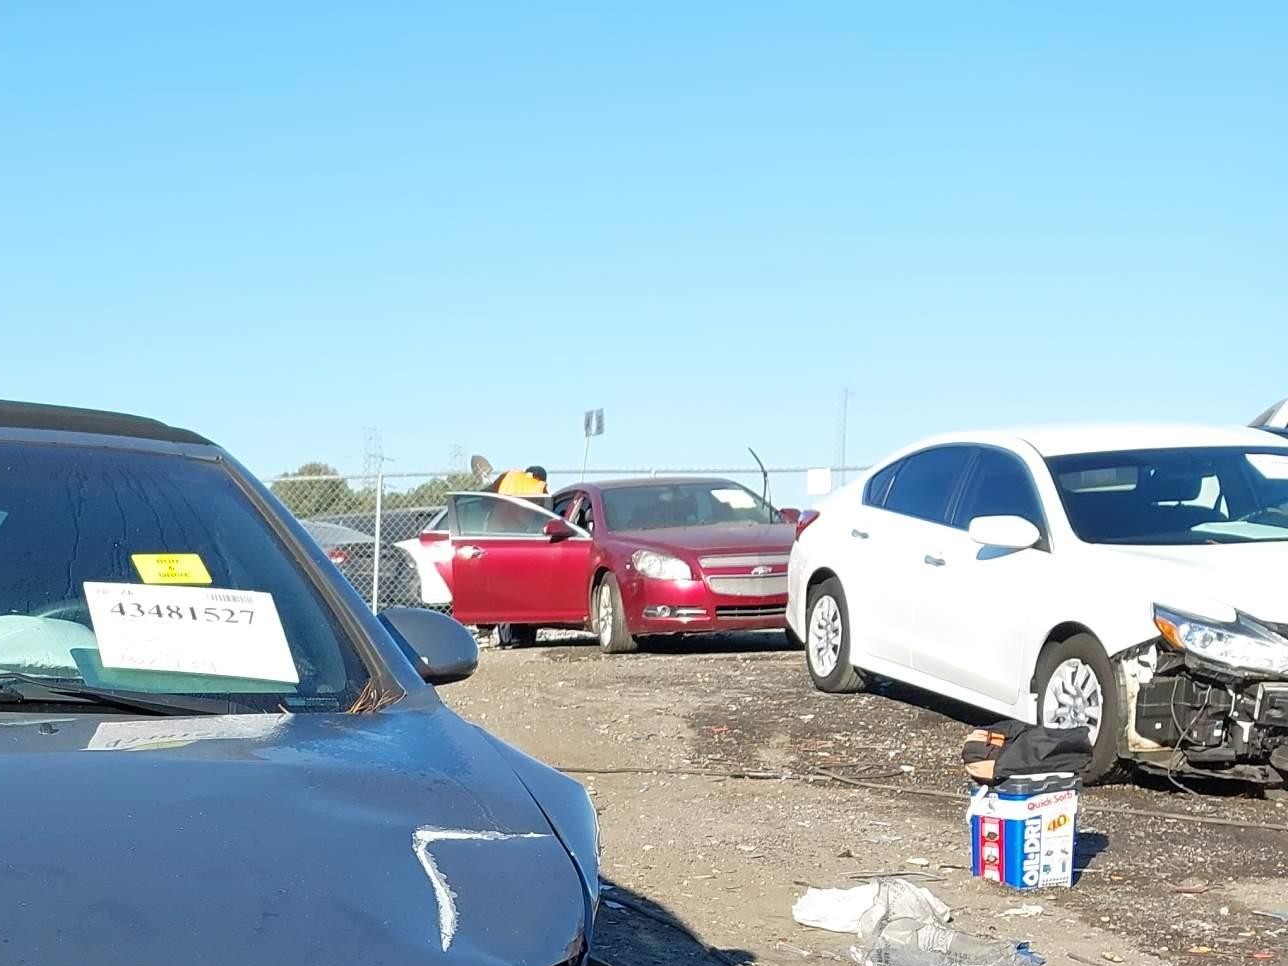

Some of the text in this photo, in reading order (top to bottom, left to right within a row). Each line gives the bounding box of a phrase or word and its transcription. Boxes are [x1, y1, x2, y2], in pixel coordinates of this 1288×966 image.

[110, 601, 255, 625] 43481527
[1027, 789, 1073, 811] Quick Sorb
[1047, 814, 1067, 832] 40
